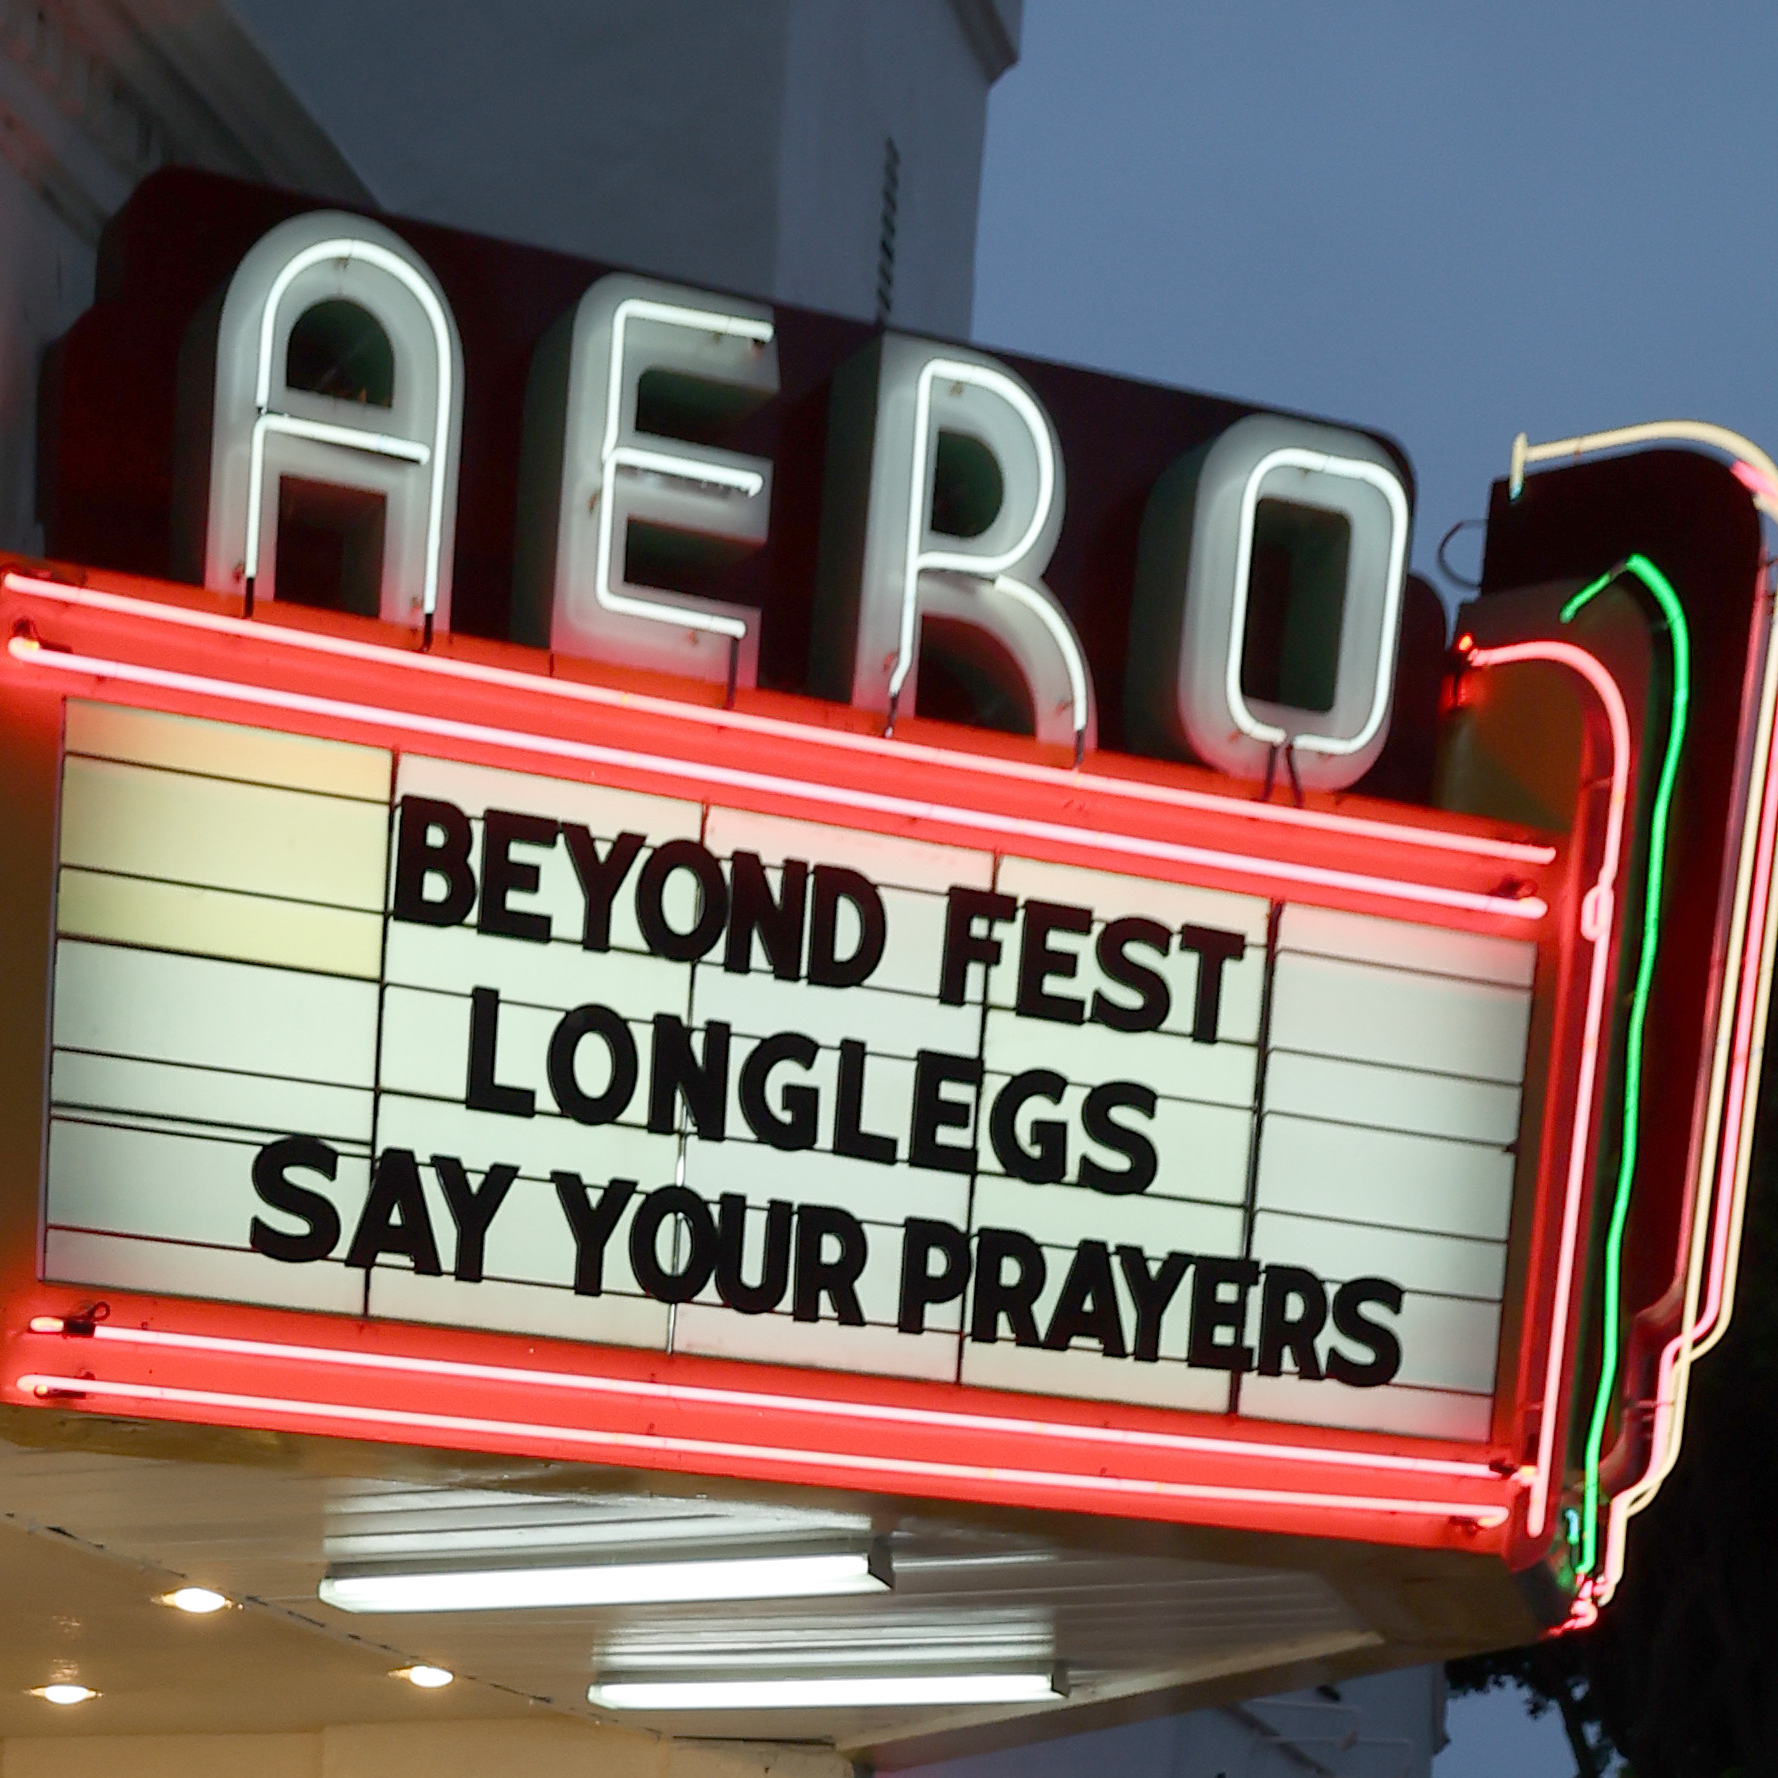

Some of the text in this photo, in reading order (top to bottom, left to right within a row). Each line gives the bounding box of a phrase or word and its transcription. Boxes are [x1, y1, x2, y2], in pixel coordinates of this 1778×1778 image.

[197, 205, 1418, 796] AERO
[392, 794, 1247, 1043] BEYOND FEST
[465, 986, 1159, 1195] LONGLEGS
[249, 1133, 1405, 1388] SAY YOUR PRAYERS
